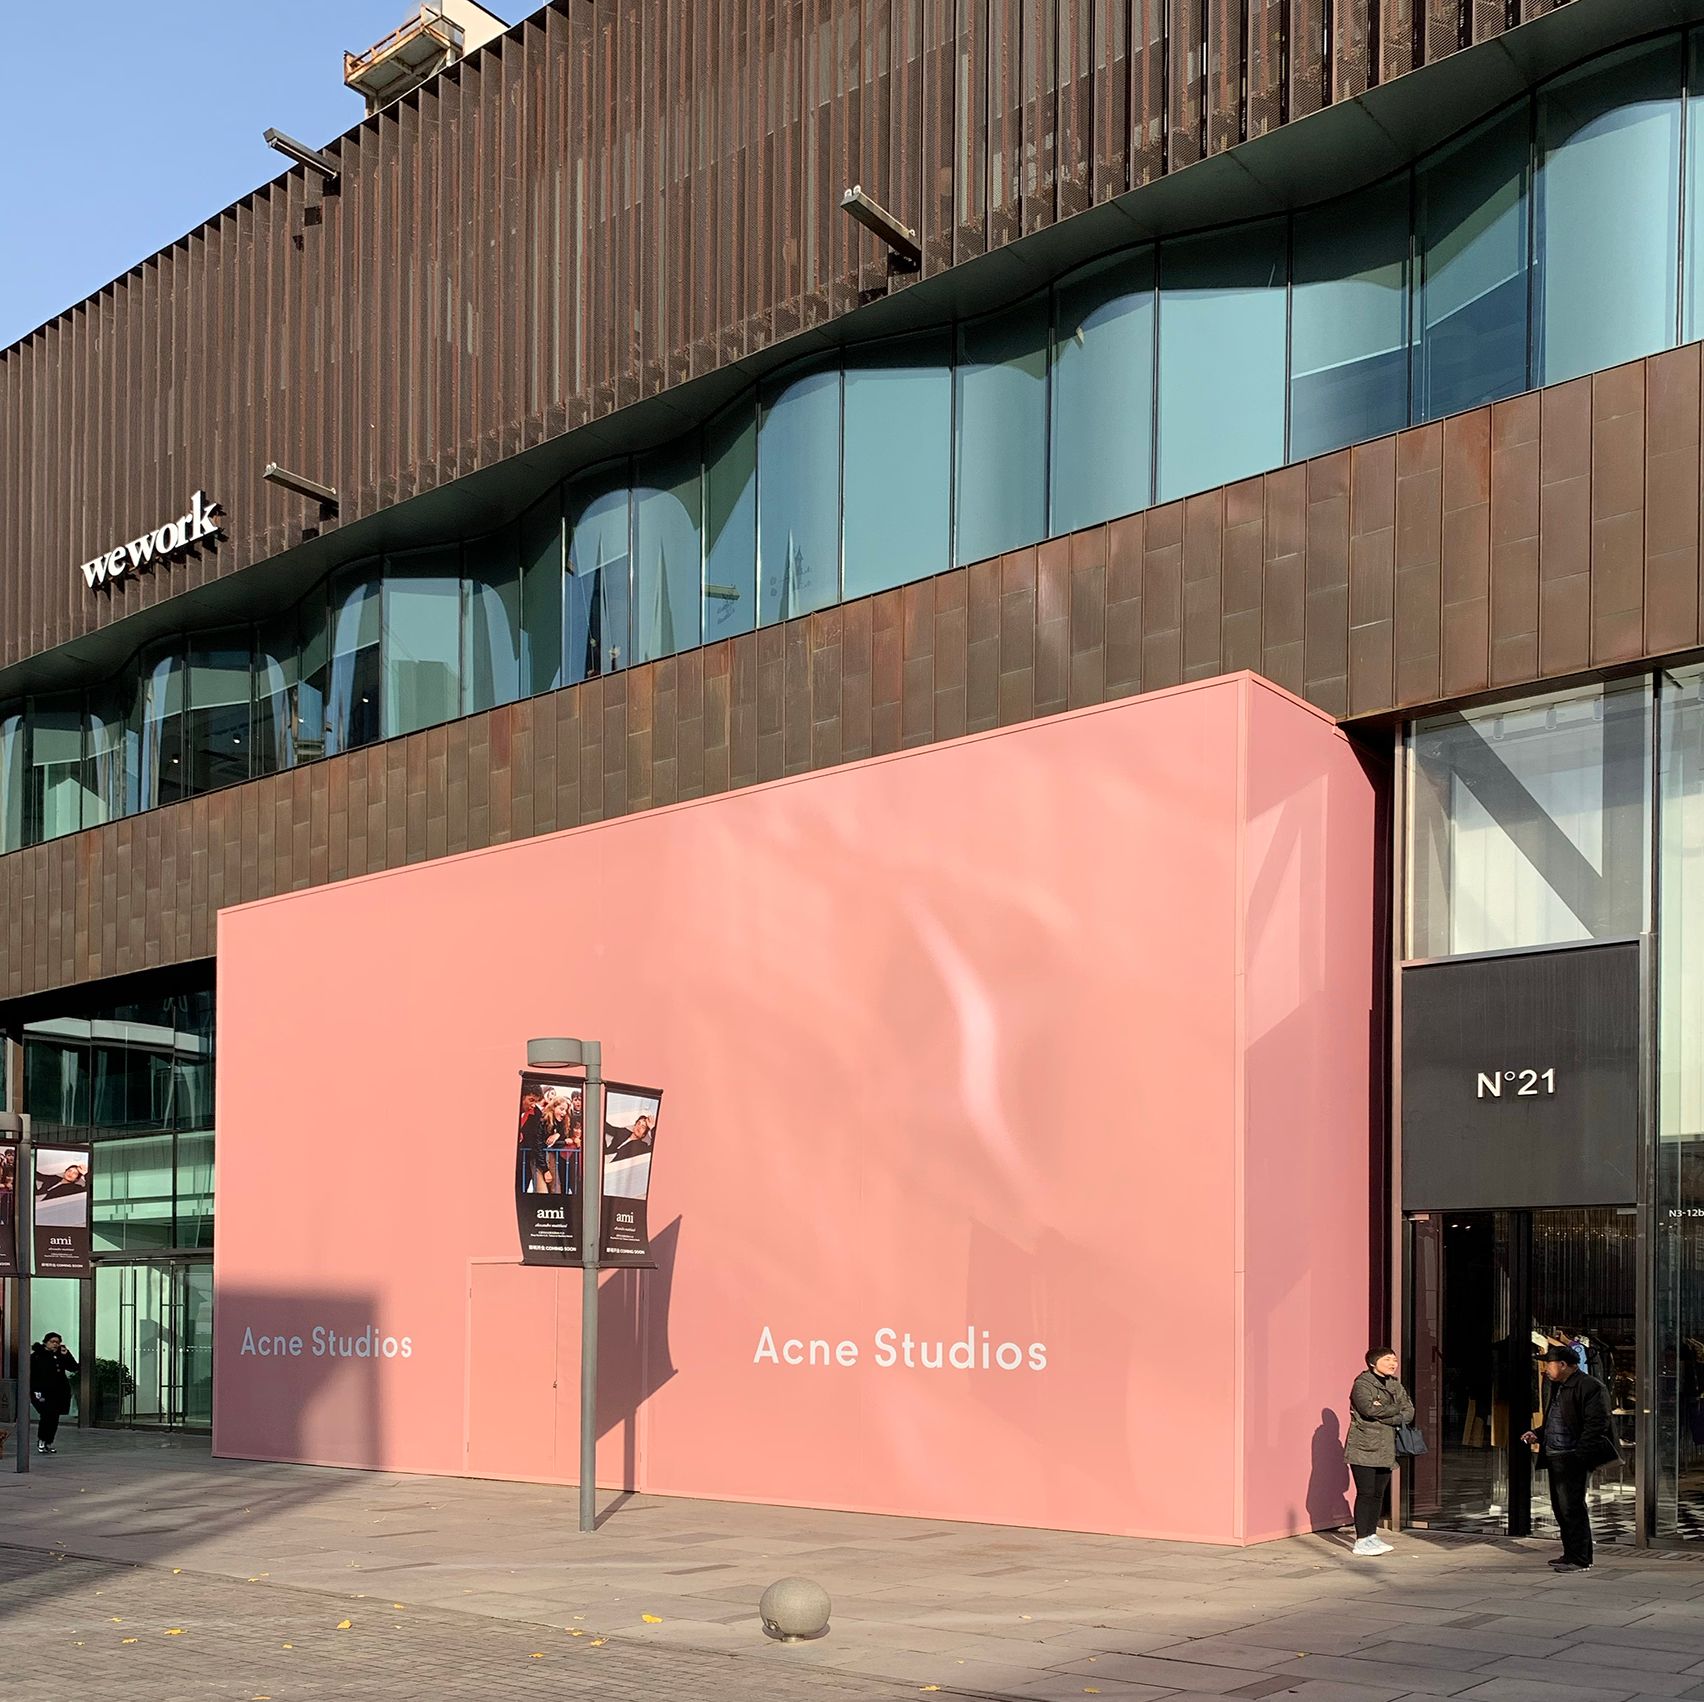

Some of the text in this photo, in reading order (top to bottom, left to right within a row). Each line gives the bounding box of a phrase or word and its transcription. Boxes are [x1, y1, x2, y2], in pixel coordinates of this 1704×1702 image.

[80, 489, 219, 589] wework
[1477, 1067, 1555, 1098] N°21
[536, 1207, 565, 1219] ami
[616, 1212, 634, 1223] ami
[49, 1236, 72, 1246] ami
[240, 1324, 413, 1358] Acne Studios
[752, 1325, 1048, 1371] Acne Studios
